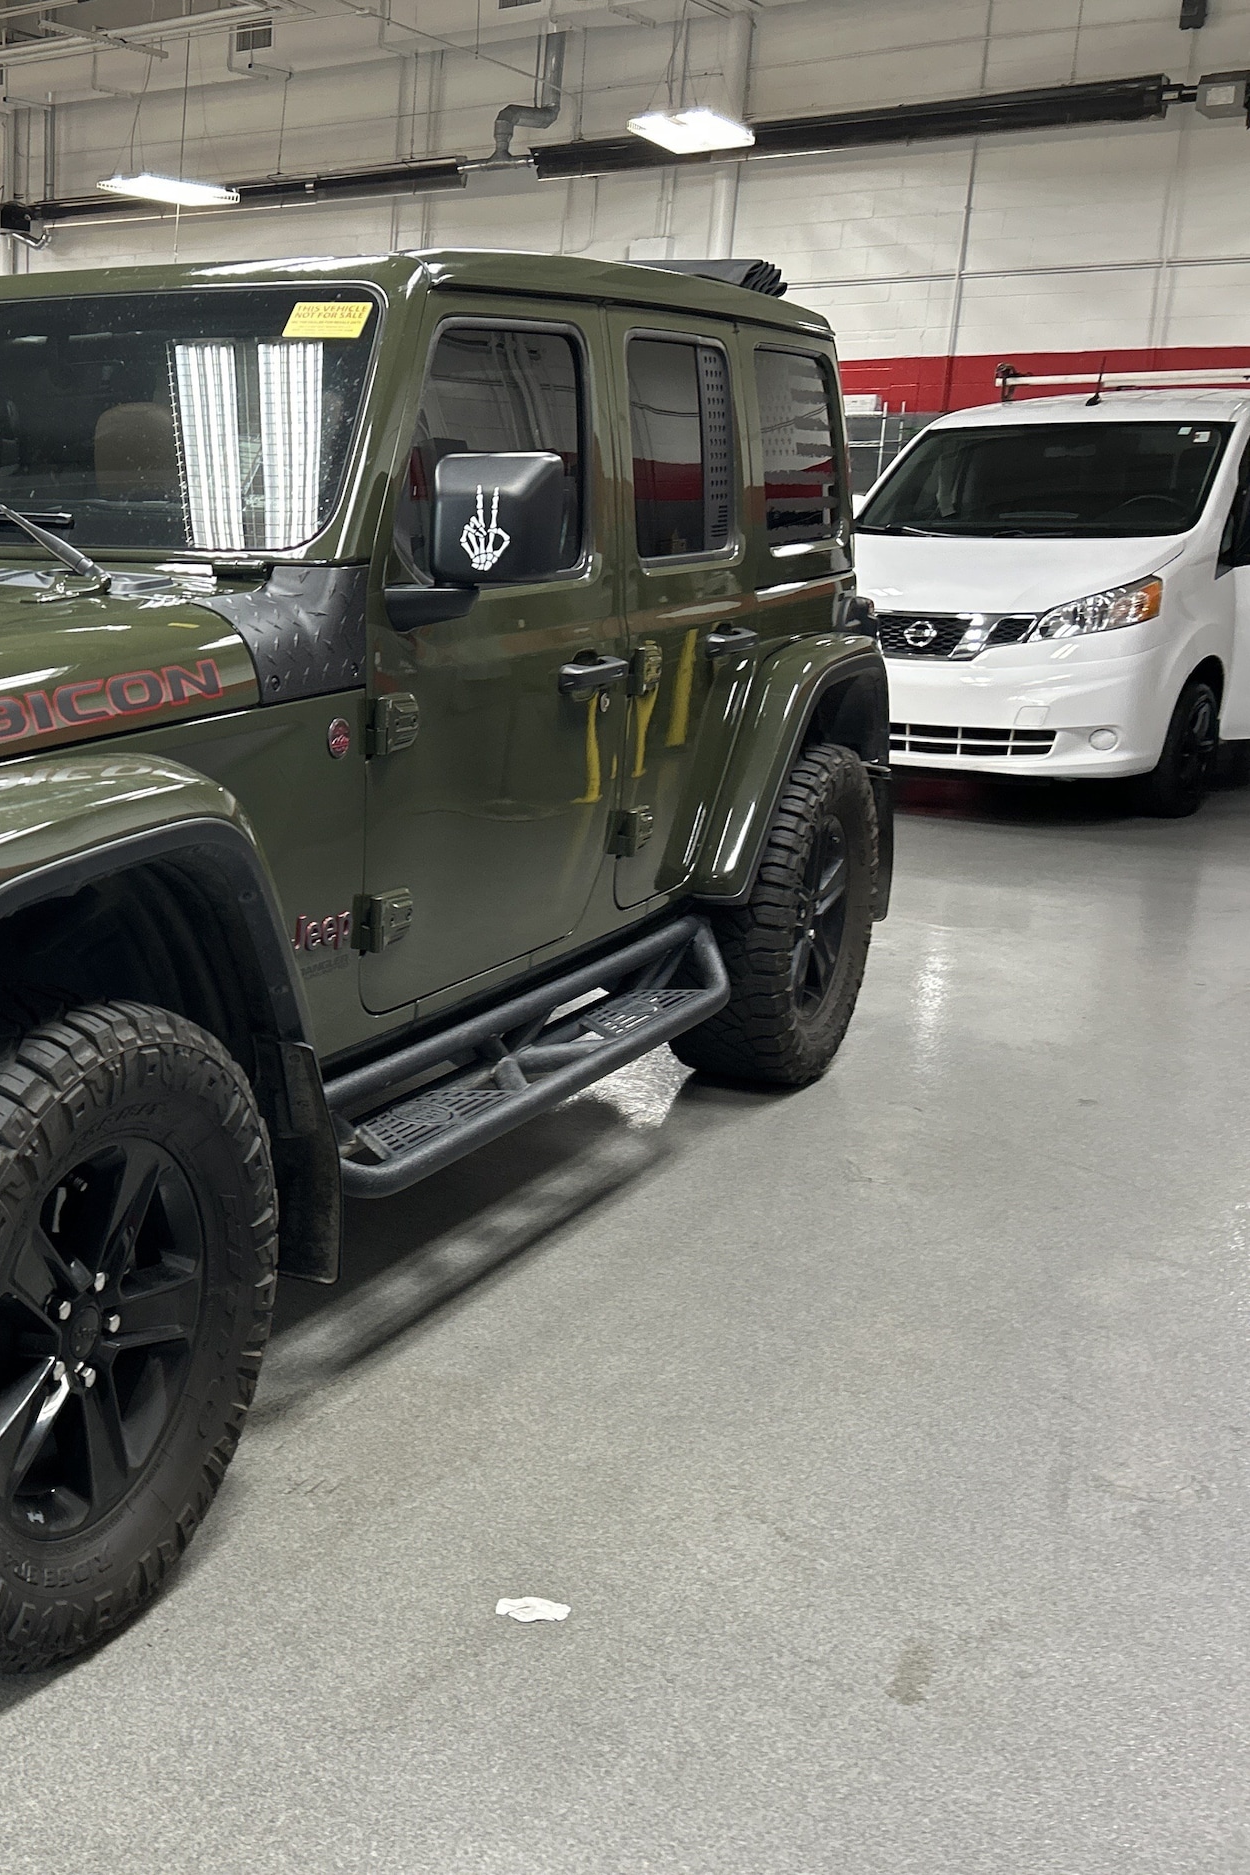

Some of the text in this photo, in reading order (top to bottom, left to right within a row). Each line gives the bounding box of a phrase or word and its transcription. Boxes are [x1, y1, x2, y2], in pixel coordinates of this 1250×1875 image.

[297, 305, 367, 313] THIS VEHICLE
[291, 909, 351, 951] Jeep
